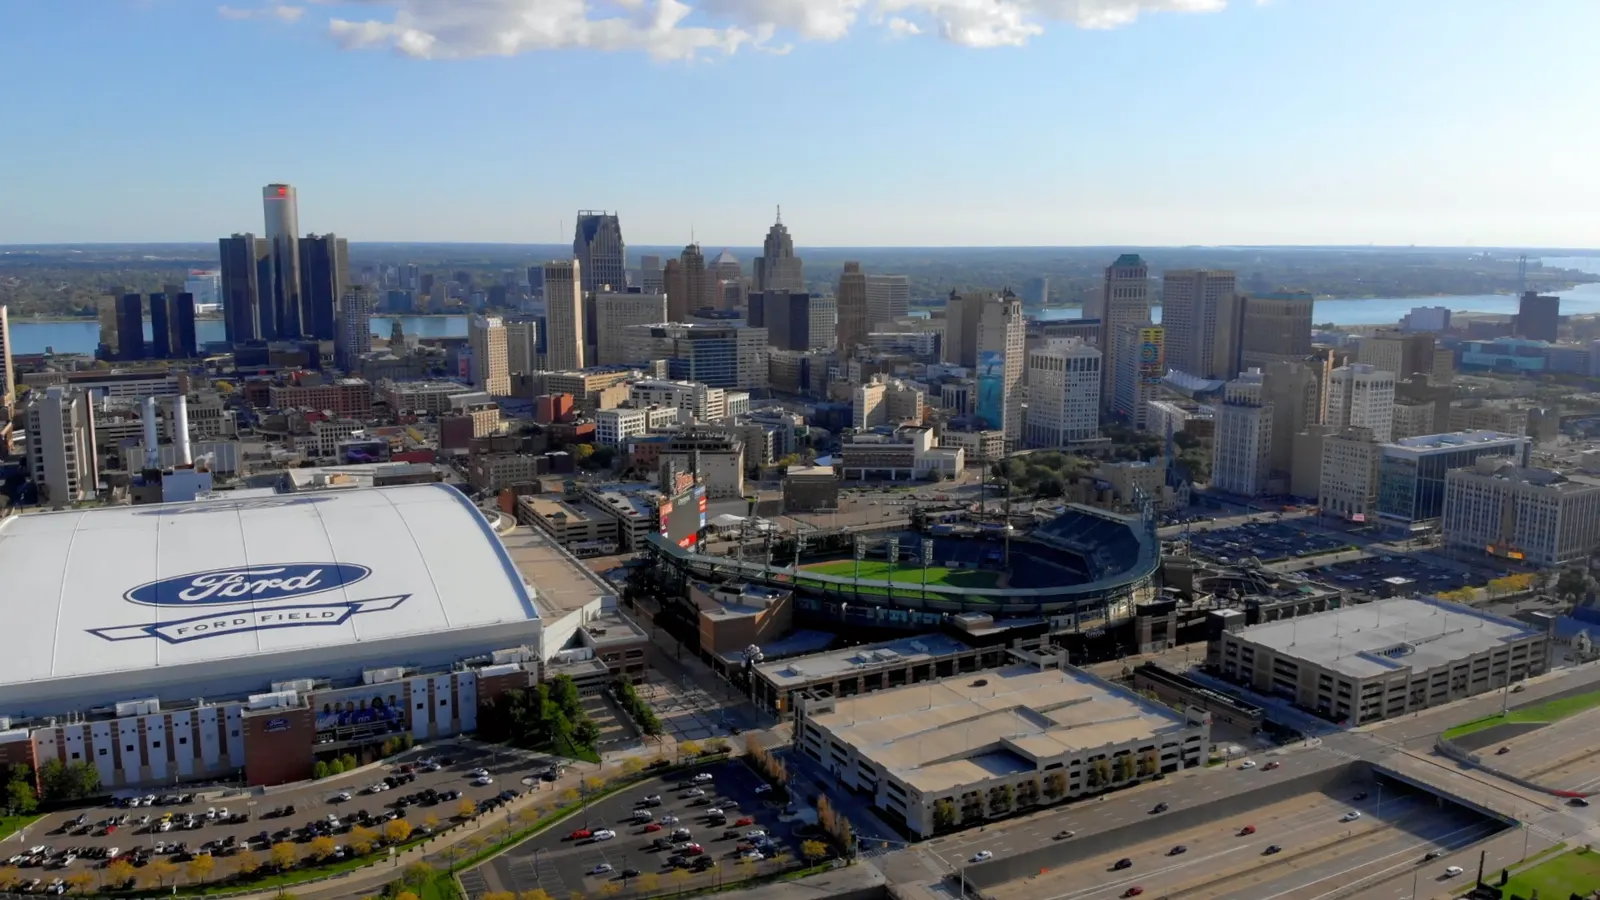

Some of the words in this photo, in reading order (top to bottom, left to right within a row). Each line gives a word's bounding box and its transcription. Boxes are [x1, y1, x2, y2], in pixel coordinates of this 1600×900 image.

[178, 567, 323, 601] Ford
[177, 618, 246, 634] FORD
[260, 611, 335, 622] FIELD
